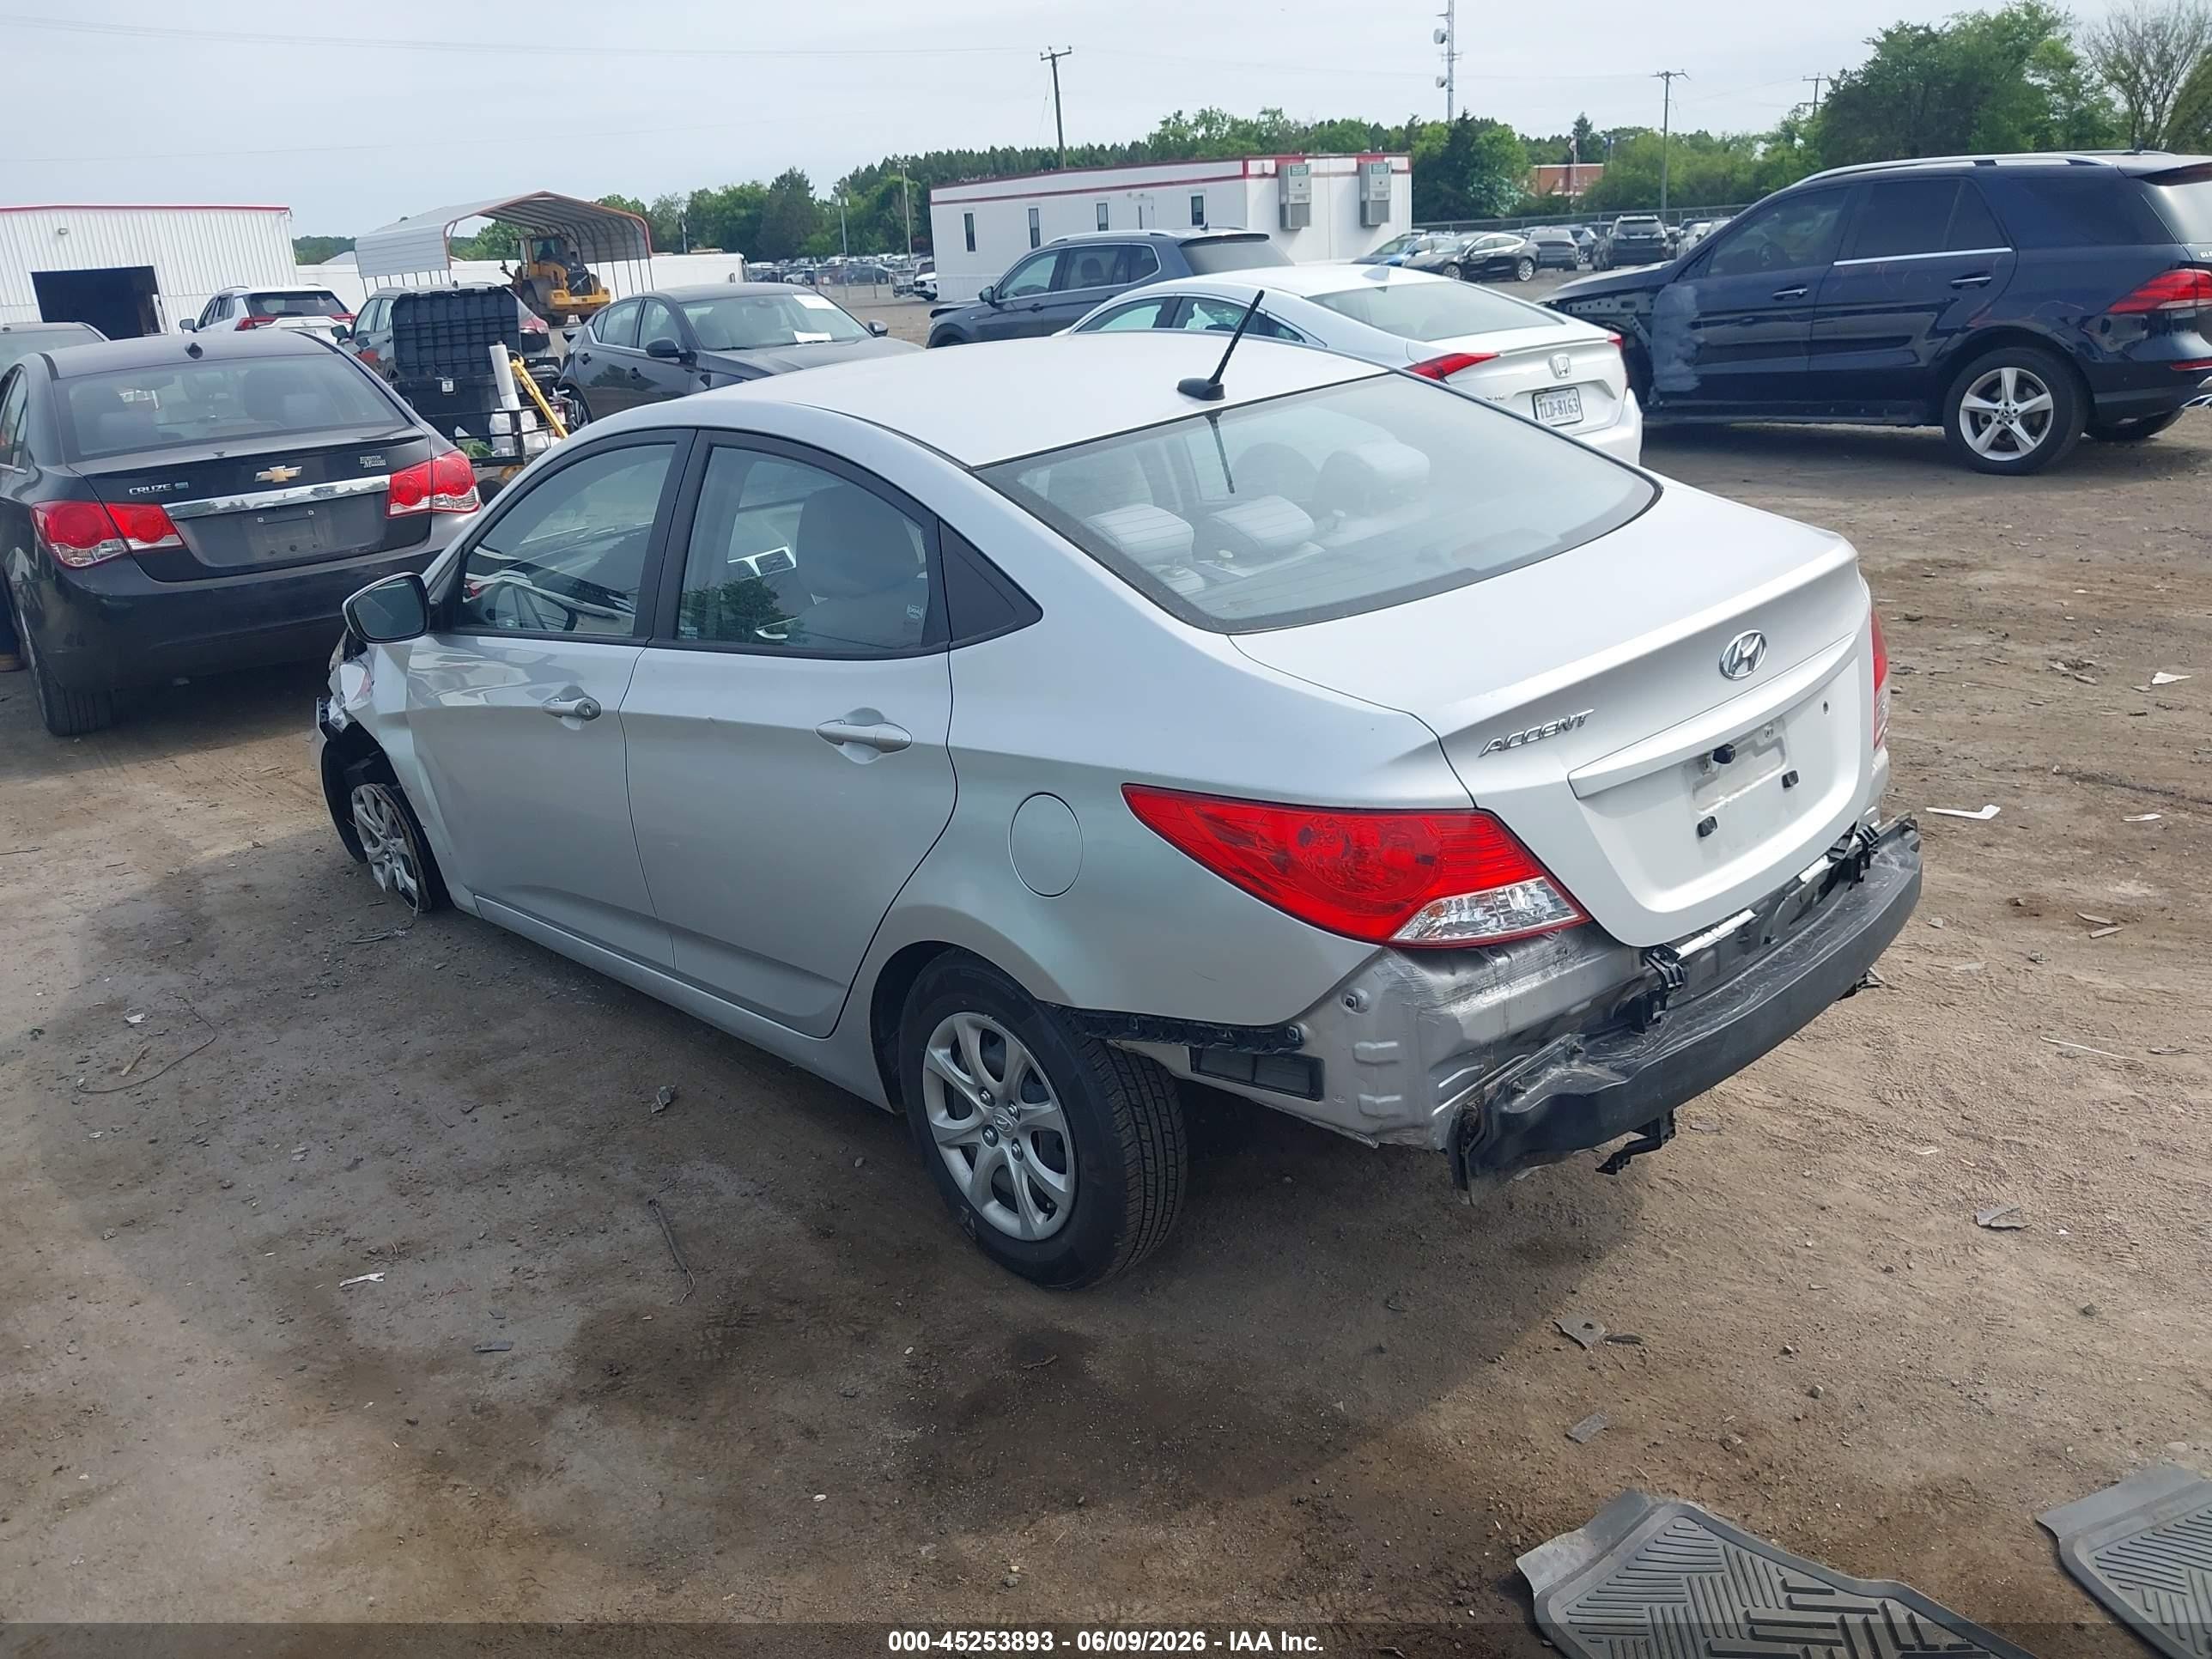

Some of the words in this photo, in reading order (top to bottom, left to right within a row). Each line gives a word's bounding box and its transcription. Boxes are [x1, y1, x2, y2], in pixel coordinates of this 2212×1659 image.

[1538, 398, 1579, 420] TLD-8163
[129, 483, 172, 495] CRUZE
[1478, 708, 1595, 757] ACCENT
